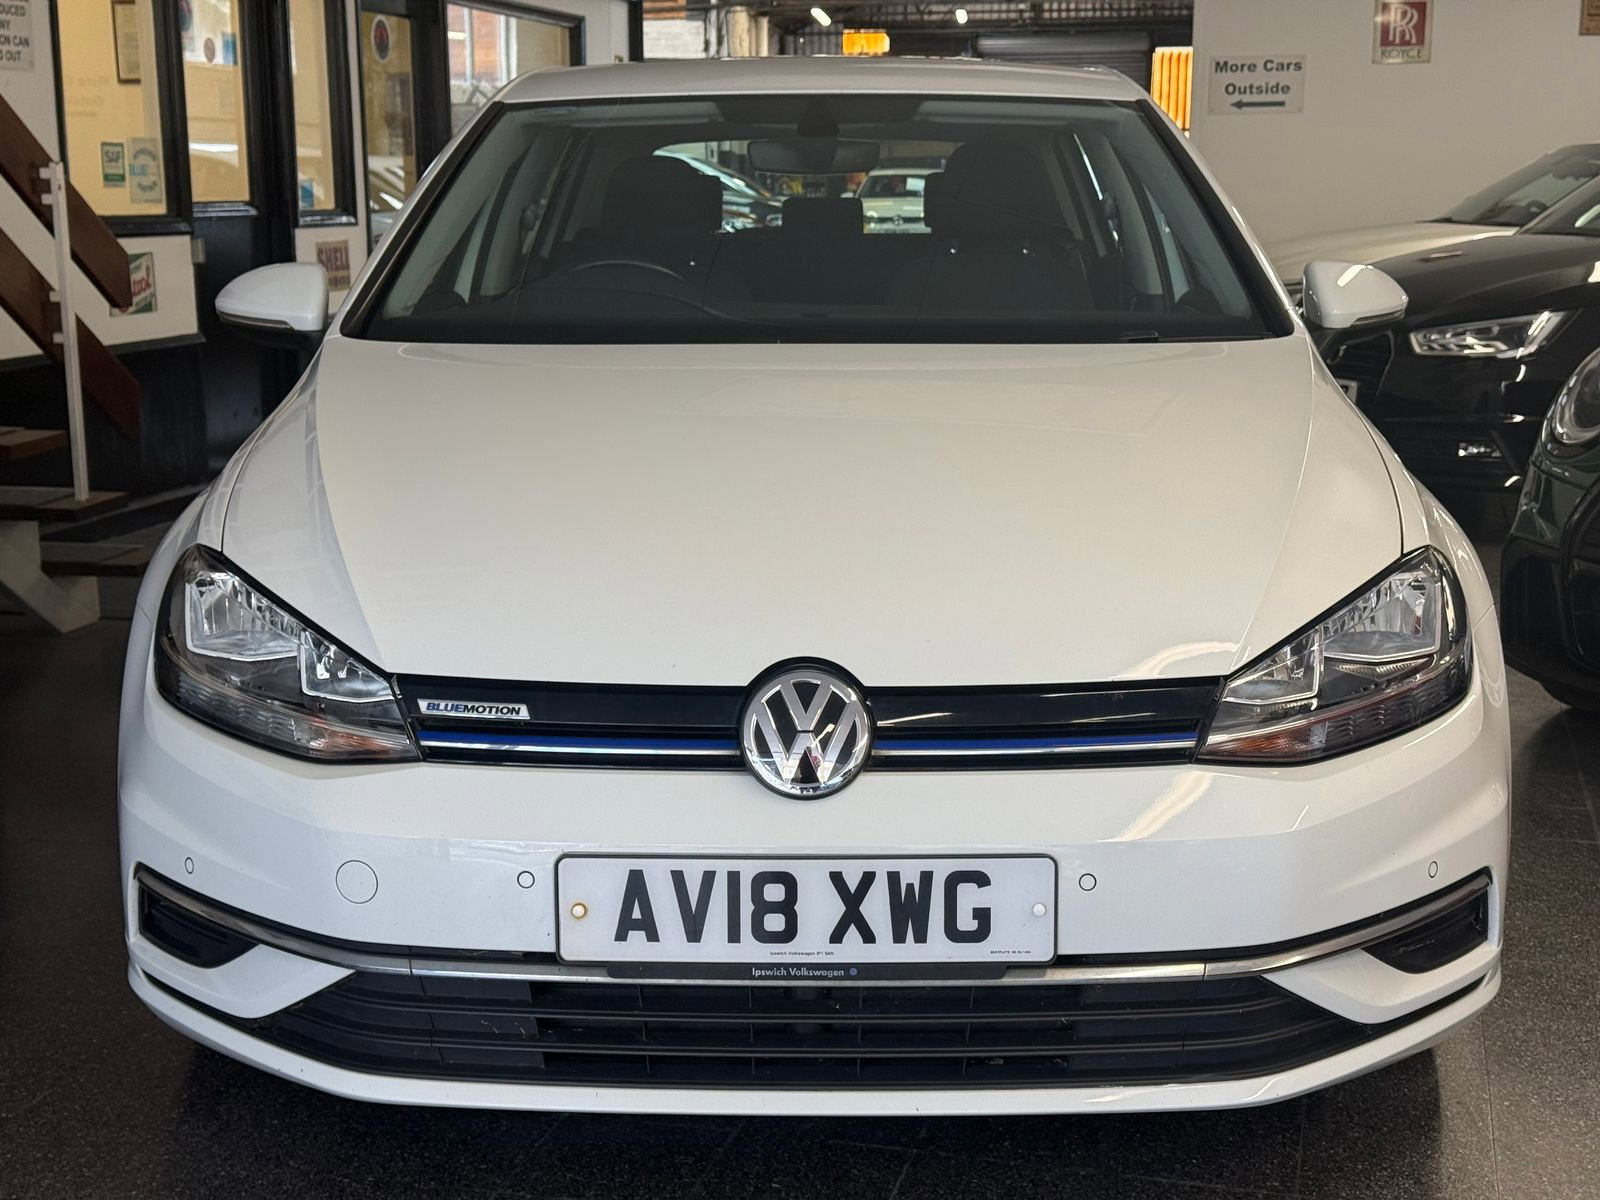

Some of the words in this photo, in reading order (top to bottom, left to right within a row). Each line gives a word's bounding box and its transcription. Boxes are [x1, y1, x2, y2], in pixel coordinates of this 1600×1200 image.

[12, 35, 30, 48] CAN
[5, 50, 22, 62] OUT
[1380, 48, 1424, 60] ROYCE
[1215, 60, 1257, 74] More
[1263, 59, 1303, 72] Cars
[1224, 82, 1291, 96] Outside
[425, 702, 521, 716] BLUEMOTION
[614, 869, 798, 944] AV18
[828, 870, 992, 945] XWG
[752, 966, 787, 977] Ipswich
[788, 967, 845, 977] Volkswagen
